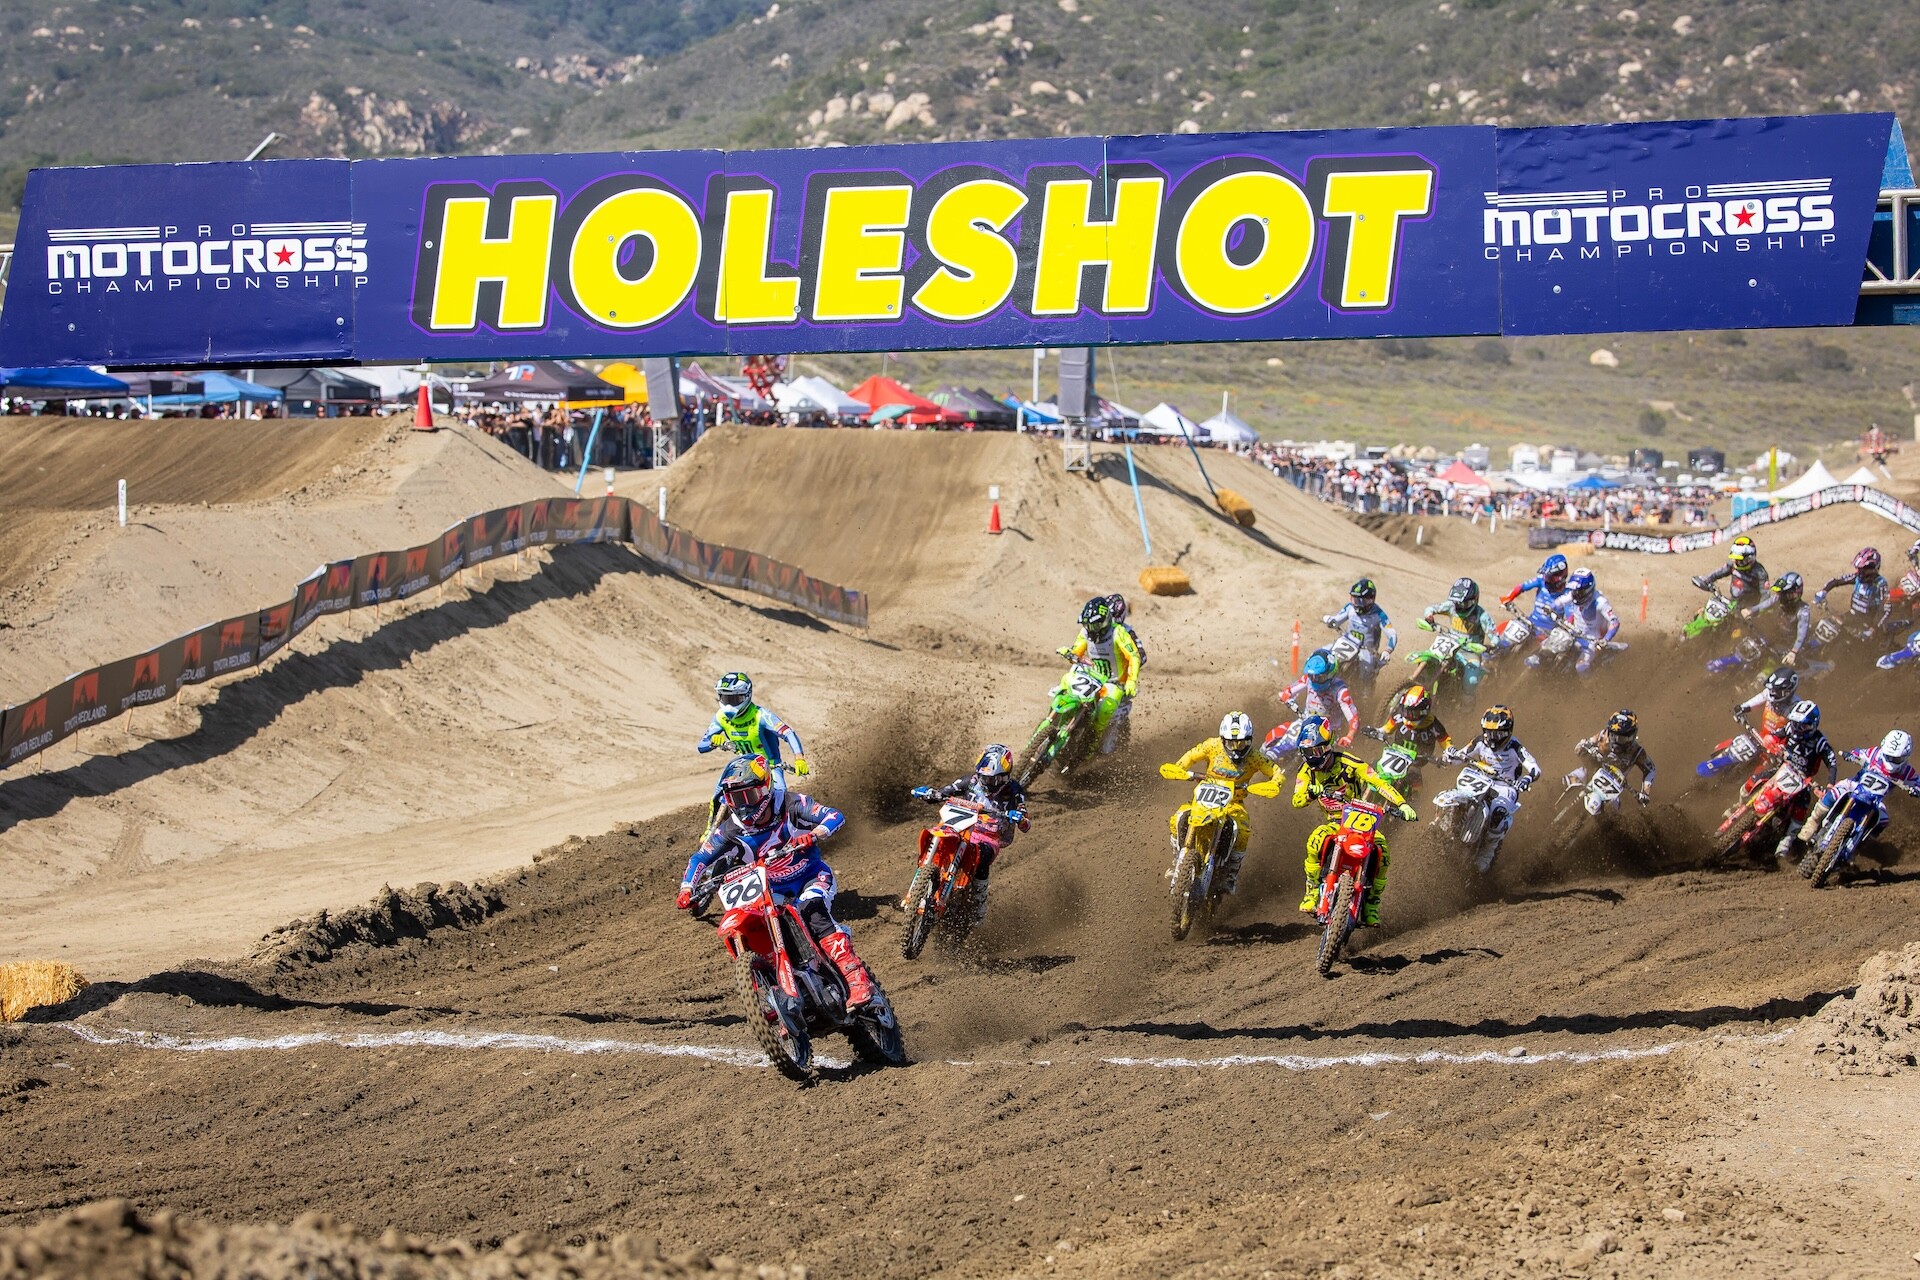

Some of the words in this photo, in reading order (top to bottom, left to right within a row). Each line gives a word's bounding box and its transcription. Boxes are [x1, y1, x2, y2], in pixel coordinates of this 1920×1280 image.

[1613, 184, 1702, 203] PRO
[1483, 194, 1835, 246] MOTOCROSS
[165, 224, 247, 238] PRO
[429, 169, 1433, 331] HOLESHOT
[1483, 232, 1837, 262] CHAMPIONSHIP
[47, 238, 368, 279] MOTOCROSS
[48, 275, 369, 295] CHAMPIONSHIP
[1071, 676, 1098, 698] 21
[79, 706, 107, 727] REDLANDS
[1382, 751, 1409, 774] 70
[1458, 775, 1487, 793] 24
[1594, 775, 1620, 796] 27
[1777, 772, 1803, 791] 17
[1860, 774, 1888, 791] 37
[1195, 788, 1231, 807] 102
[944, 808, 975, 826] 7
[1343, 811, 1378, 832] 18
[768, 858, 809, 880] HONDA
[726, 880, 762, 908] 96
